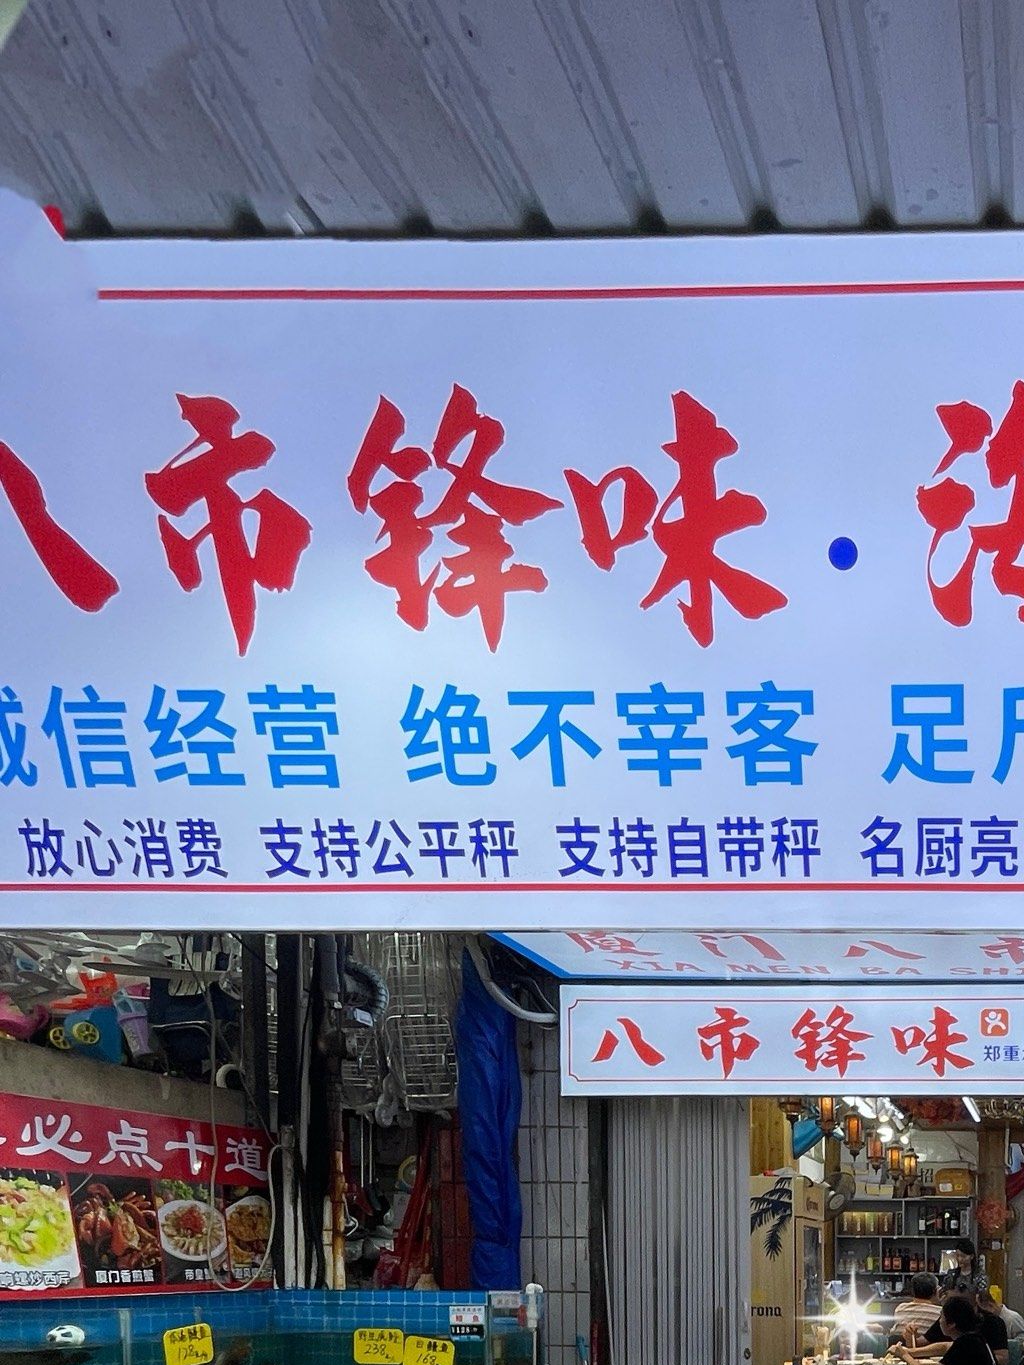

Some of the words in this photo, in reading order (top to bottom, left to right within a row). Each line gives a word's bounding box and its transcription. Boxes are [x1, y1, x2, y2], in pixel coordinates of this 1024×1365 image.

[400, 681, 819, 788] 绝不宰客
[18, 817, 229, 879] 放心消费
[259, 818, 520, 879] 支持公平秤
[555, 816, 821, 879] 支持自带秤
[604, 958, 705, 973] XIA
[727, 963, 831, 975] MEN
[860, 966, 922, 976] BA
[590, 1004, 976, 1079] 八市锋味
[0, 1112, 270, 1180] 必点十道
[750, 1306, 782, 1318] rona
